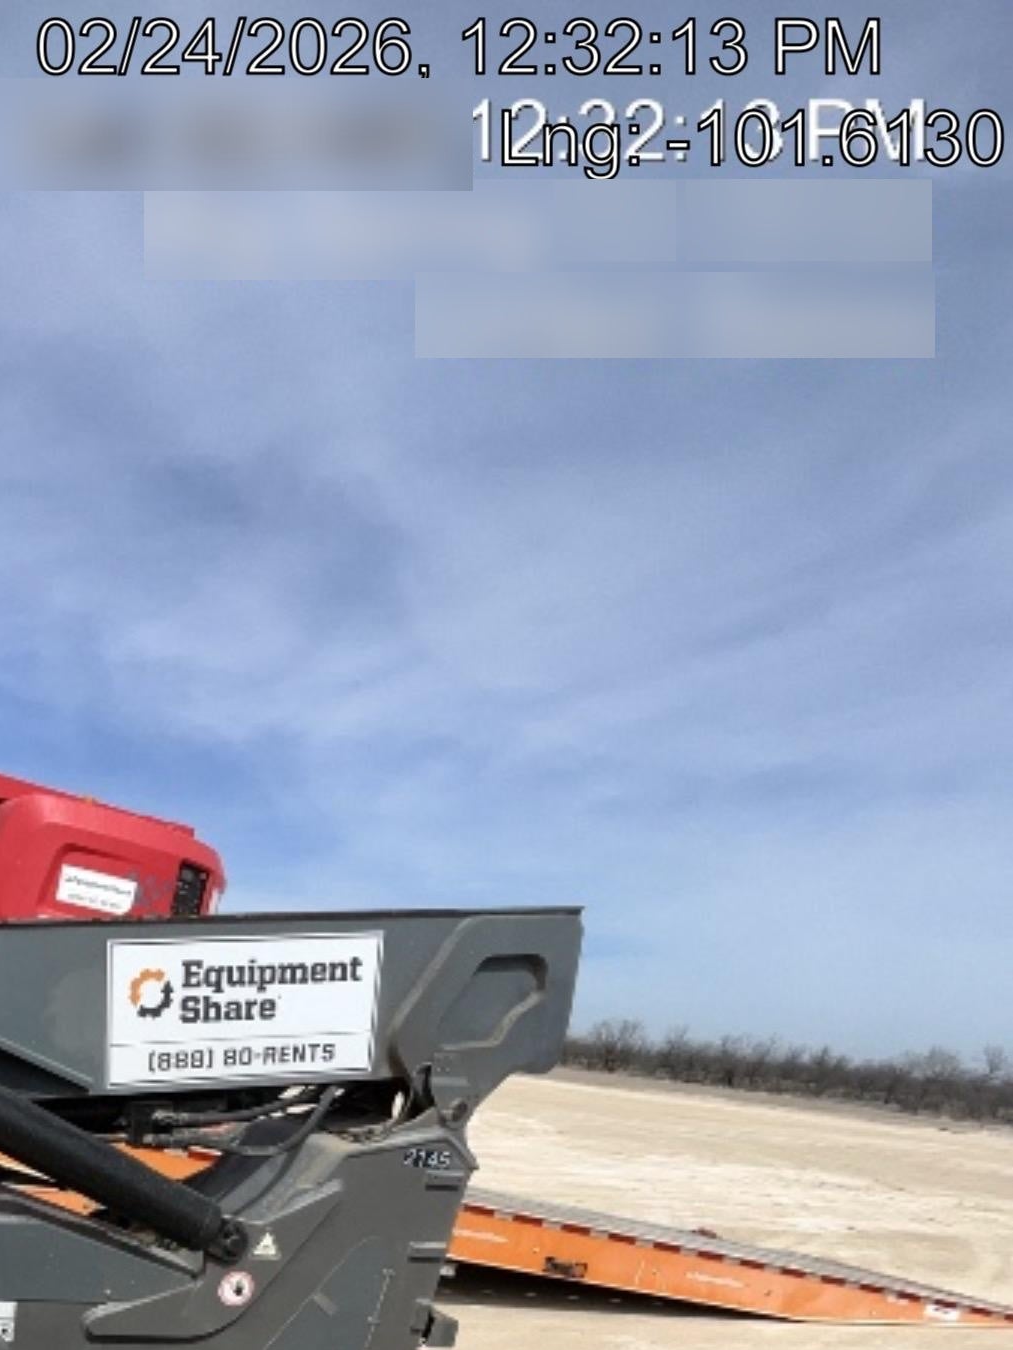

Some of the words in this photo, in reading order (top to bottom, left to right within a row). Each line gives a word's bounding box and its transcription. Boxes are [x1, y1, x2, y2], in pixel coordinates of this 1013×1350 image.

[181, 956, 363, 993] Equipment
[179, 995, 277, 1024] Share
[223, 1043, 336, 1066] 80-RENTS
